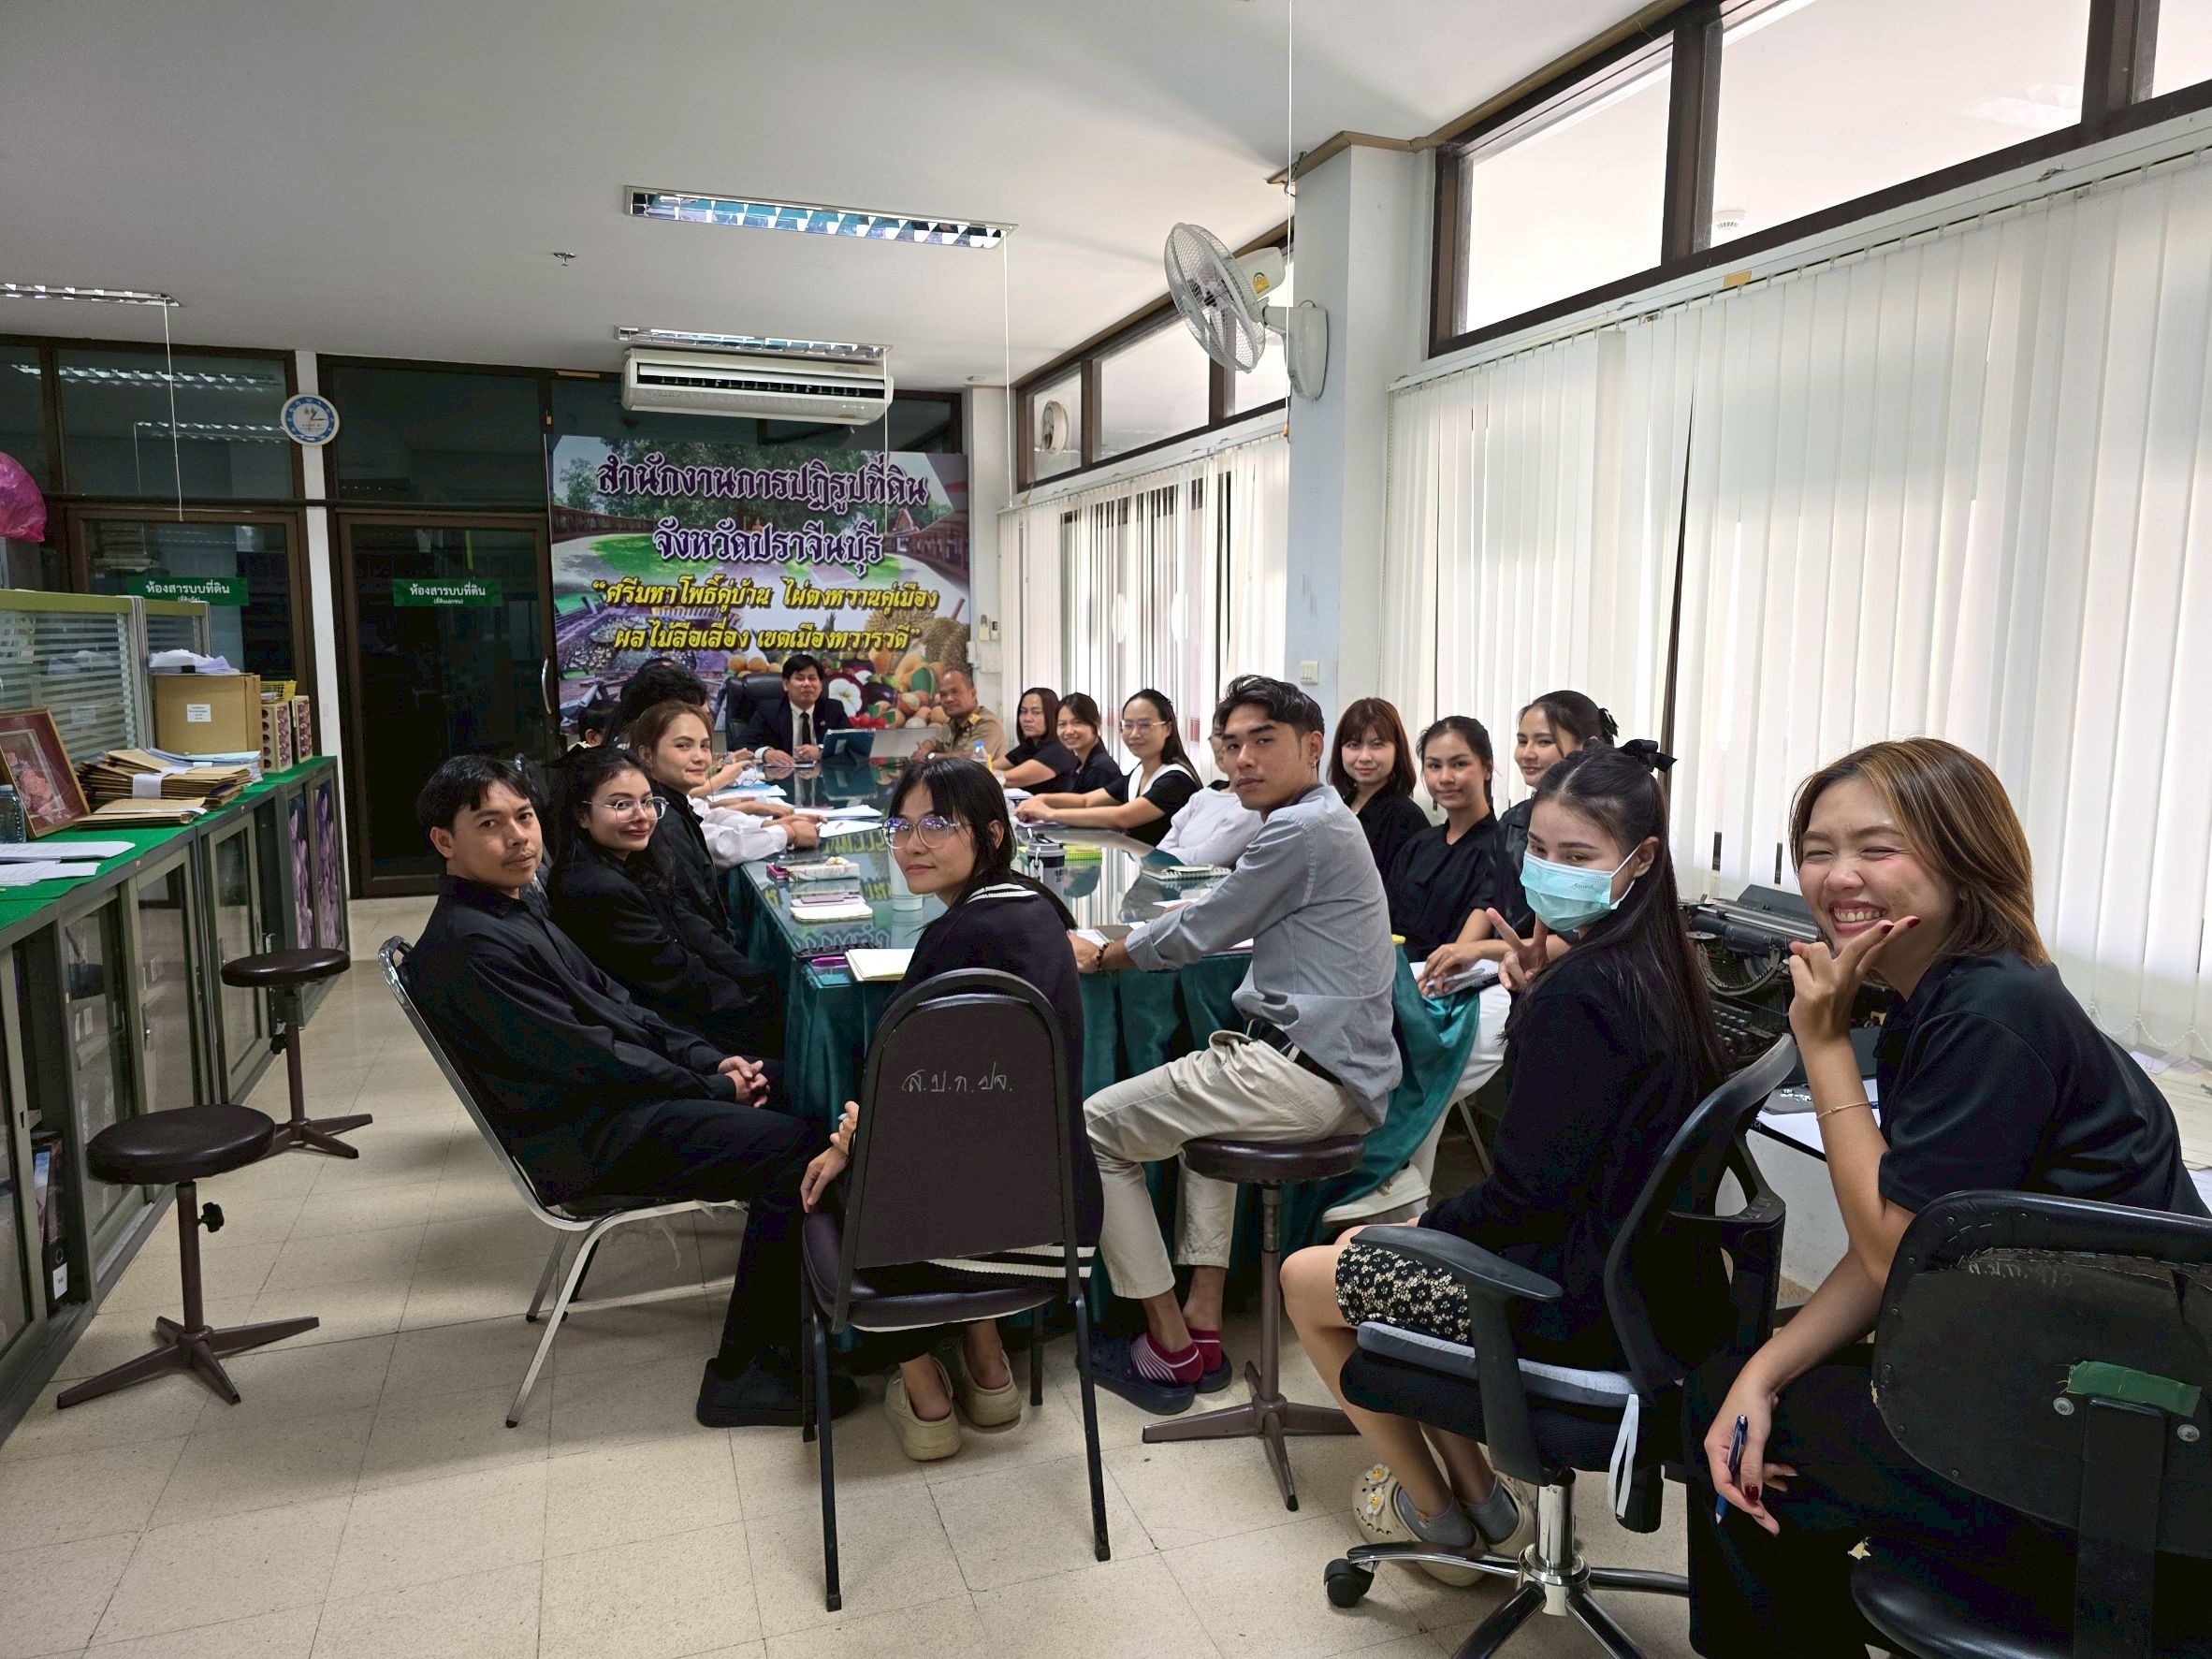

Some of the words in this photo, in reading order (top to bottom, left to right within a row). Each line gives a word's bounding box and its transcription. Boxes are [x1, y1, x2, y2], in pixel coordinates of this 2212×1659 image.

[597, 452, 928, 515] สำนักงานการปฏิรูปที่ดิน
[653, 517, 883, 575] จังหวัดปราจีนบุรี
[145, 579, 230, 594] ห้องสารบบที่ดิน
[410, 581, 487, 596] ห้องสารบบที่ดิน
[780, 575, 939, 615] ไผ่ตงหวานคู่เมือง
